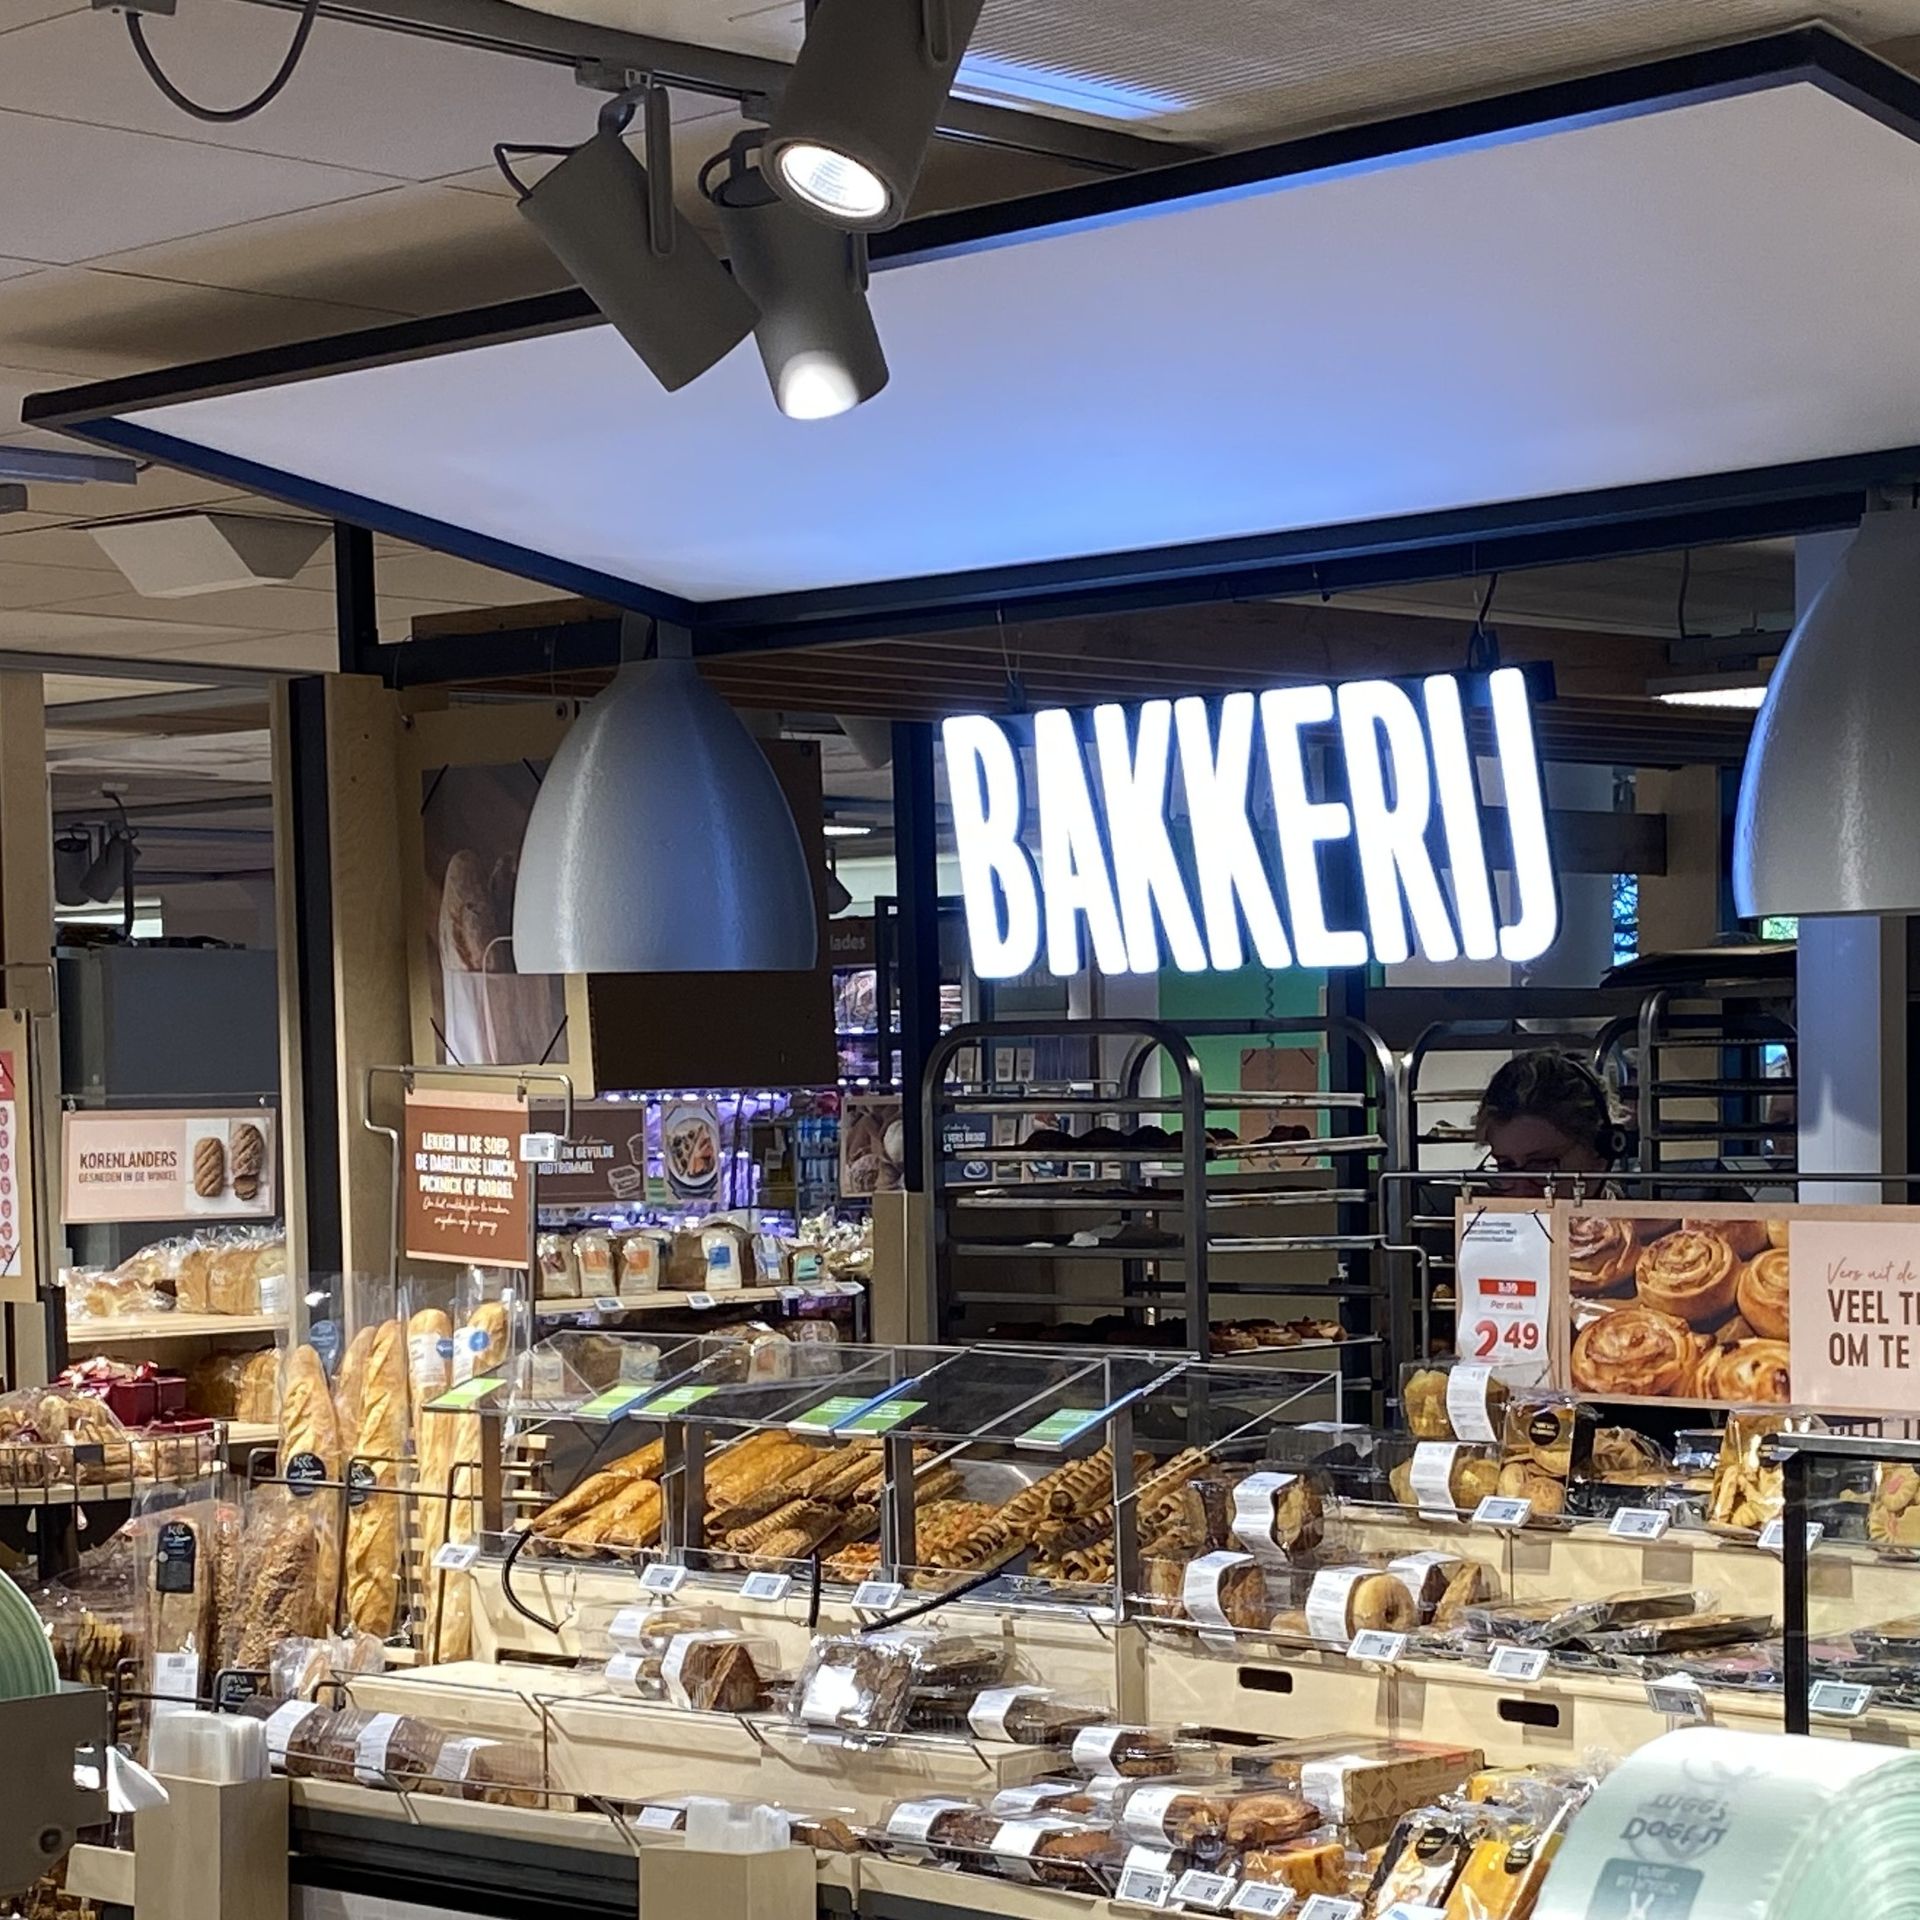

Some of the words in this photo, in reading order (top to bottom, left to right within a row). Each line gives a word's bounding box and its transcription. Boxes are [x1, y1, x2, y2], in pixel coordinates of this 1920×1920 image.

[942, 667, 1559, 979] BAKKERIJ
[469, 1135, 482, 1154] DE
[80, 1151, 177, 1169] KORENLANDERS
[415, 1153, 428, 1171] DE
[79, 1171, 121, 1183] GESNEDEN
[123, 1171, 133, 1182] IN
[135, 1171, 146, 1182] DE
[147, 1170, 177, 1181] WINKEL
[464, 1177, 477, 1196] OF
[1827, 1256, 1863, 1285] Vers
[1866, 1260, 1893, 1282] uit
[1896, 1260, 1918, 1281] de
[1828, 1288, 1890, 1325] VEEL
[1474, 1319, 1498, 1357] 2
[1504, 1321, 1540, 1351] 49
[1829, 1332, 1869, 1368] OM
[1878, 1334, 1910, 1369] TE
